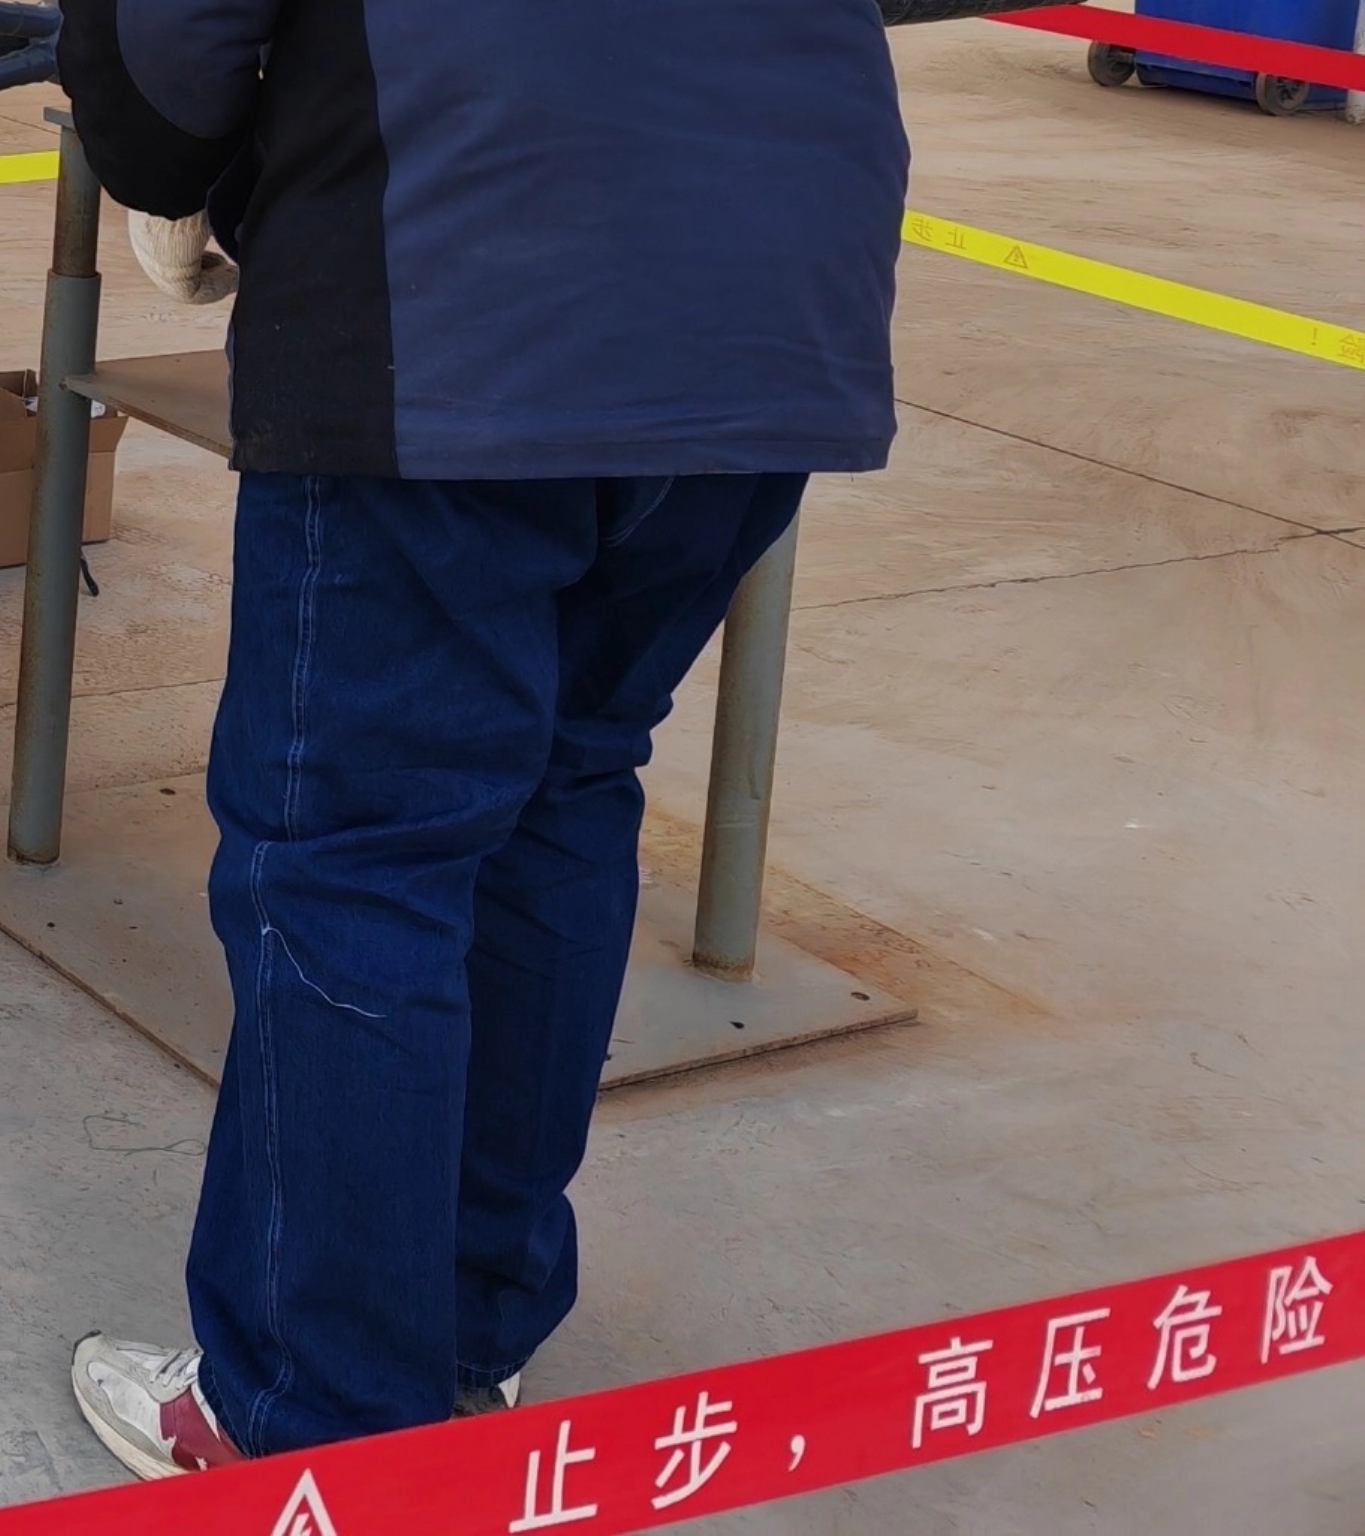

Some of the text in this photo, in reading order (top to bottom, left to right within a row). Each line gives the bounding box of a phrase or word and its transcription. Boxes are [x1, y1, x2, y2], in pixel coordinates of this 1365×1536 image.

[508, 1256, 1334, 1534] 止步，高压危险
